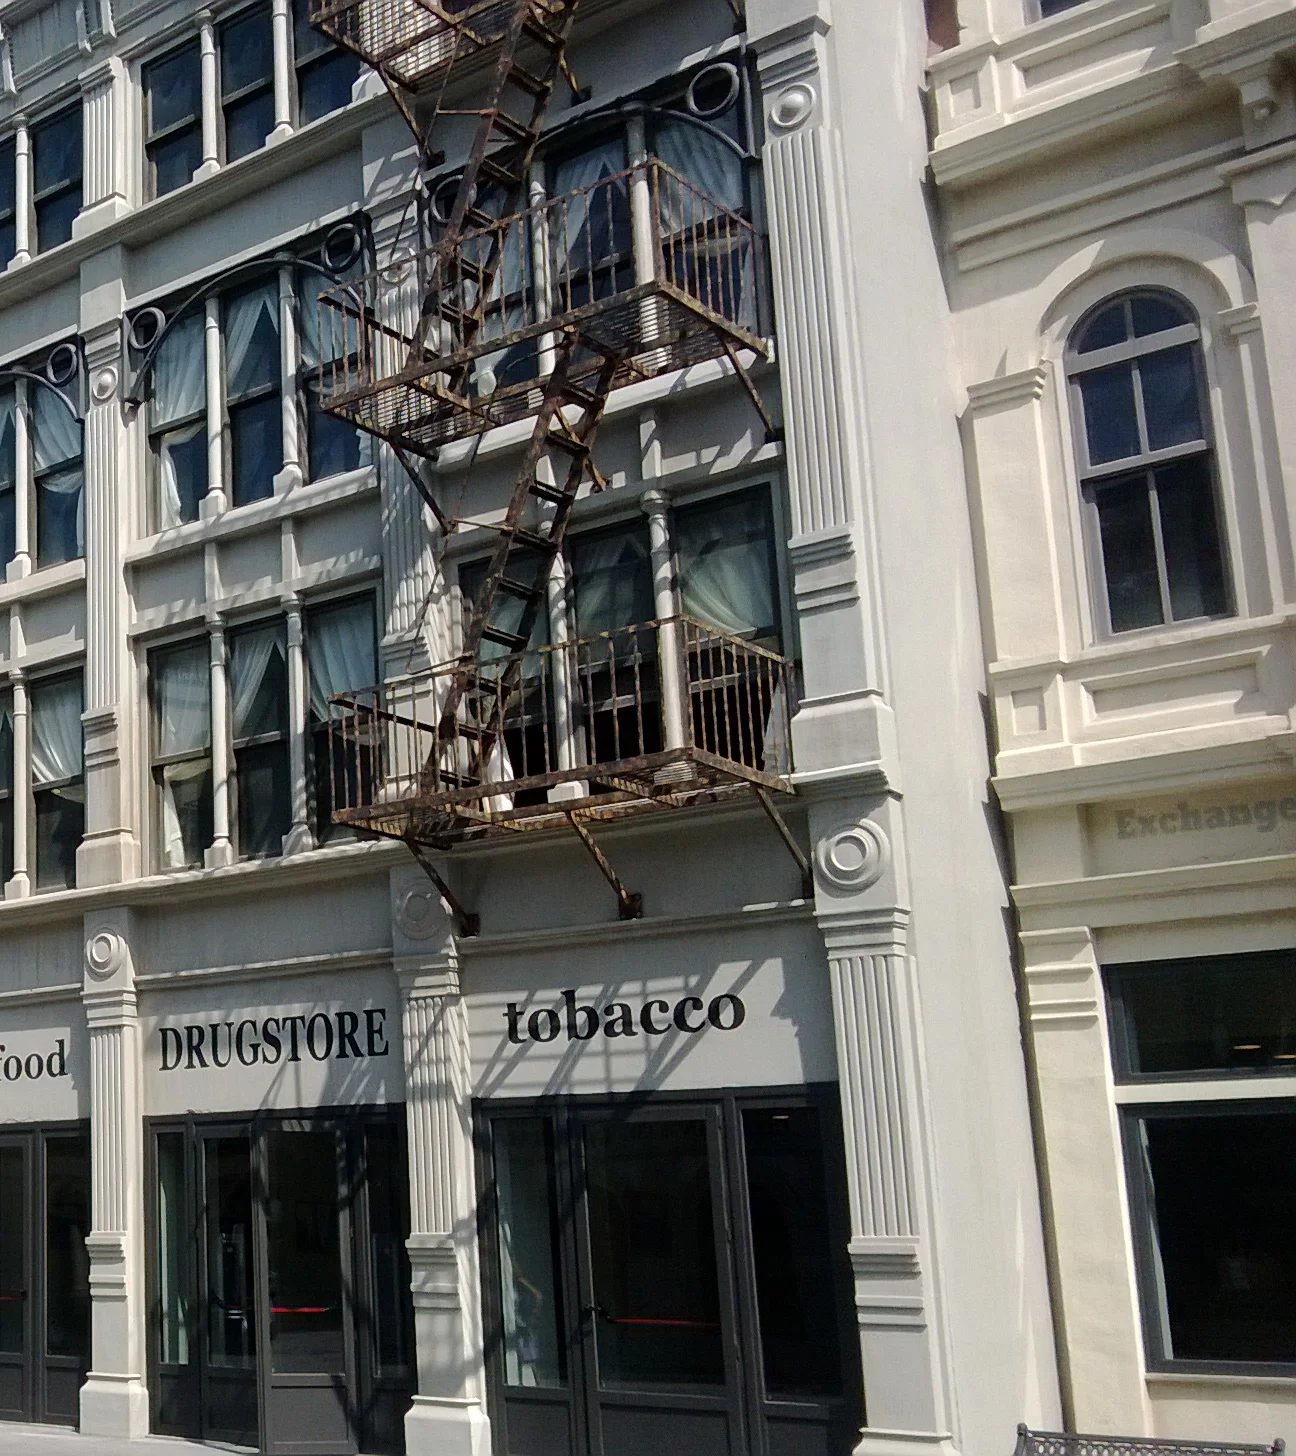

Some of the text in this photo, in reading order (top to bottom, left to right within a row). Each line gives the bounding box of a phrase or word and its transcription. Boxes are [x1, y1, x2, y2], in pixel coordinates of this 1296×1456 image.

[1115, 797, 1296, 840] Exchange
[159, 1008, 389, 1071] DRUGSTORE
[502, 989, 746, 1044] tobacco
